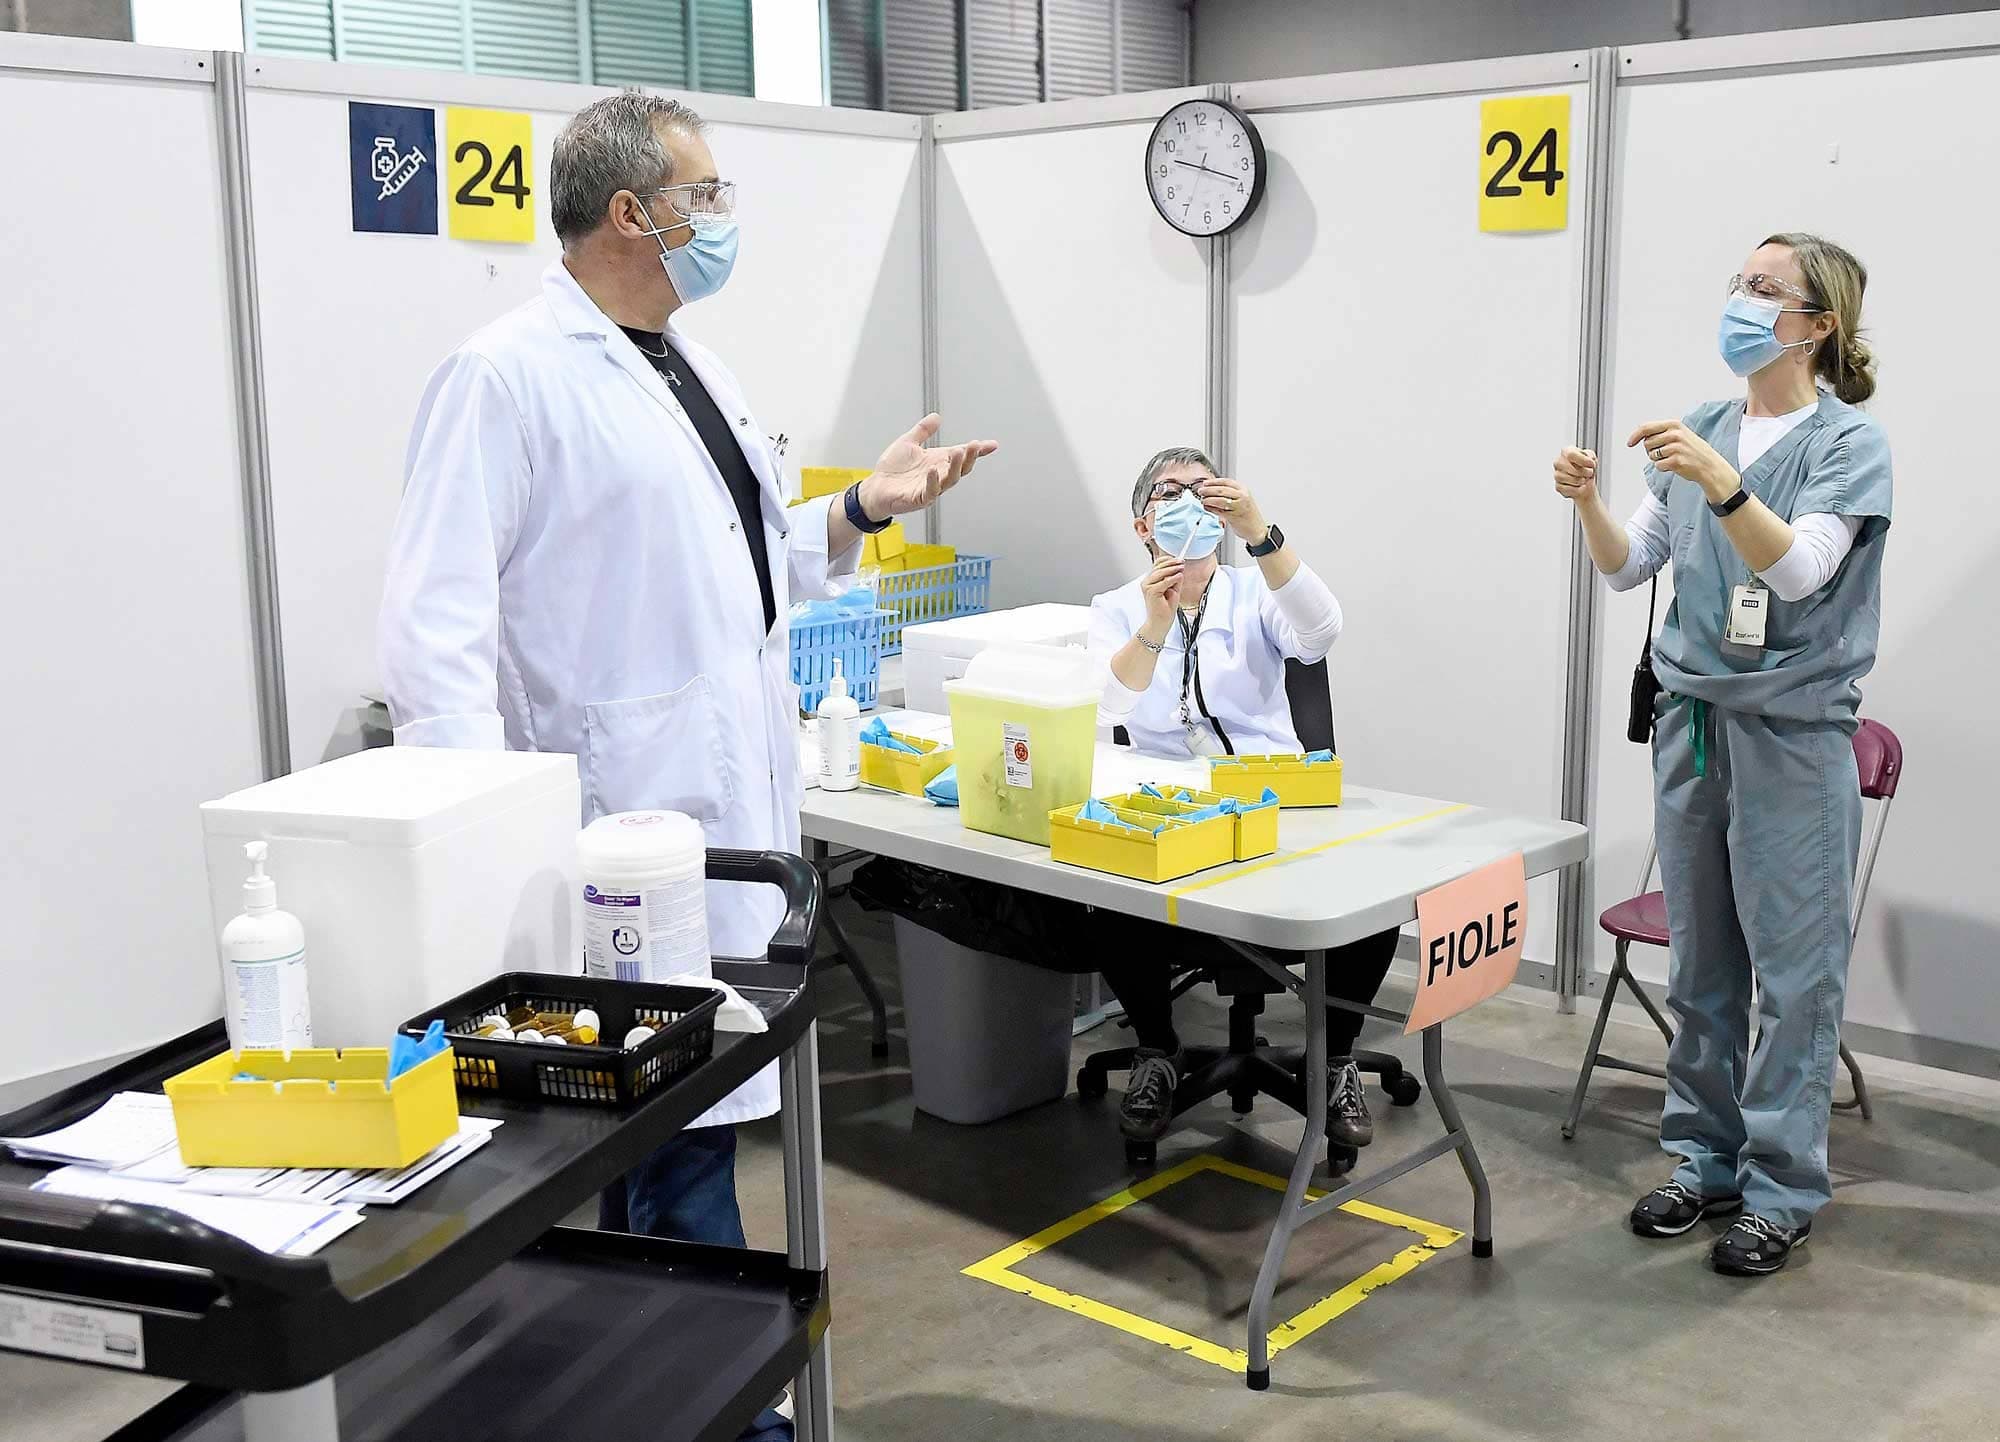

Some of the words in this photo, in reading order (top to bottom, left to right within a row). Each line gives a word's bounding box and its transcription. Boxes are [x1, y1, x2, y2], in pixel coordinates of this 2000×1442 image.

[1194, 113, 1206, 126] 12
[1218, 118, 1223, 130] 1
[1177, 121, 1186, 134] 11
[1163, 139, 1175, 153] 10
[1232, 134, 1240, 148] 2
[1241, 157, 1249, 171] 3
[1485, 127, 1564, 198] 24
[454, 140, 531, 210] 24
[1160, 165, 1167, 178] 9
[1167, 187, 1175, 199] 8
[1236, 182, 1244, 194] 4
[1183, 203, 1190, 216] 7
[1223, 201, 1231, 214] 5
[1203, 211, 1212, 224] 6
[1426, 901, 1519, 987] FIOLE
